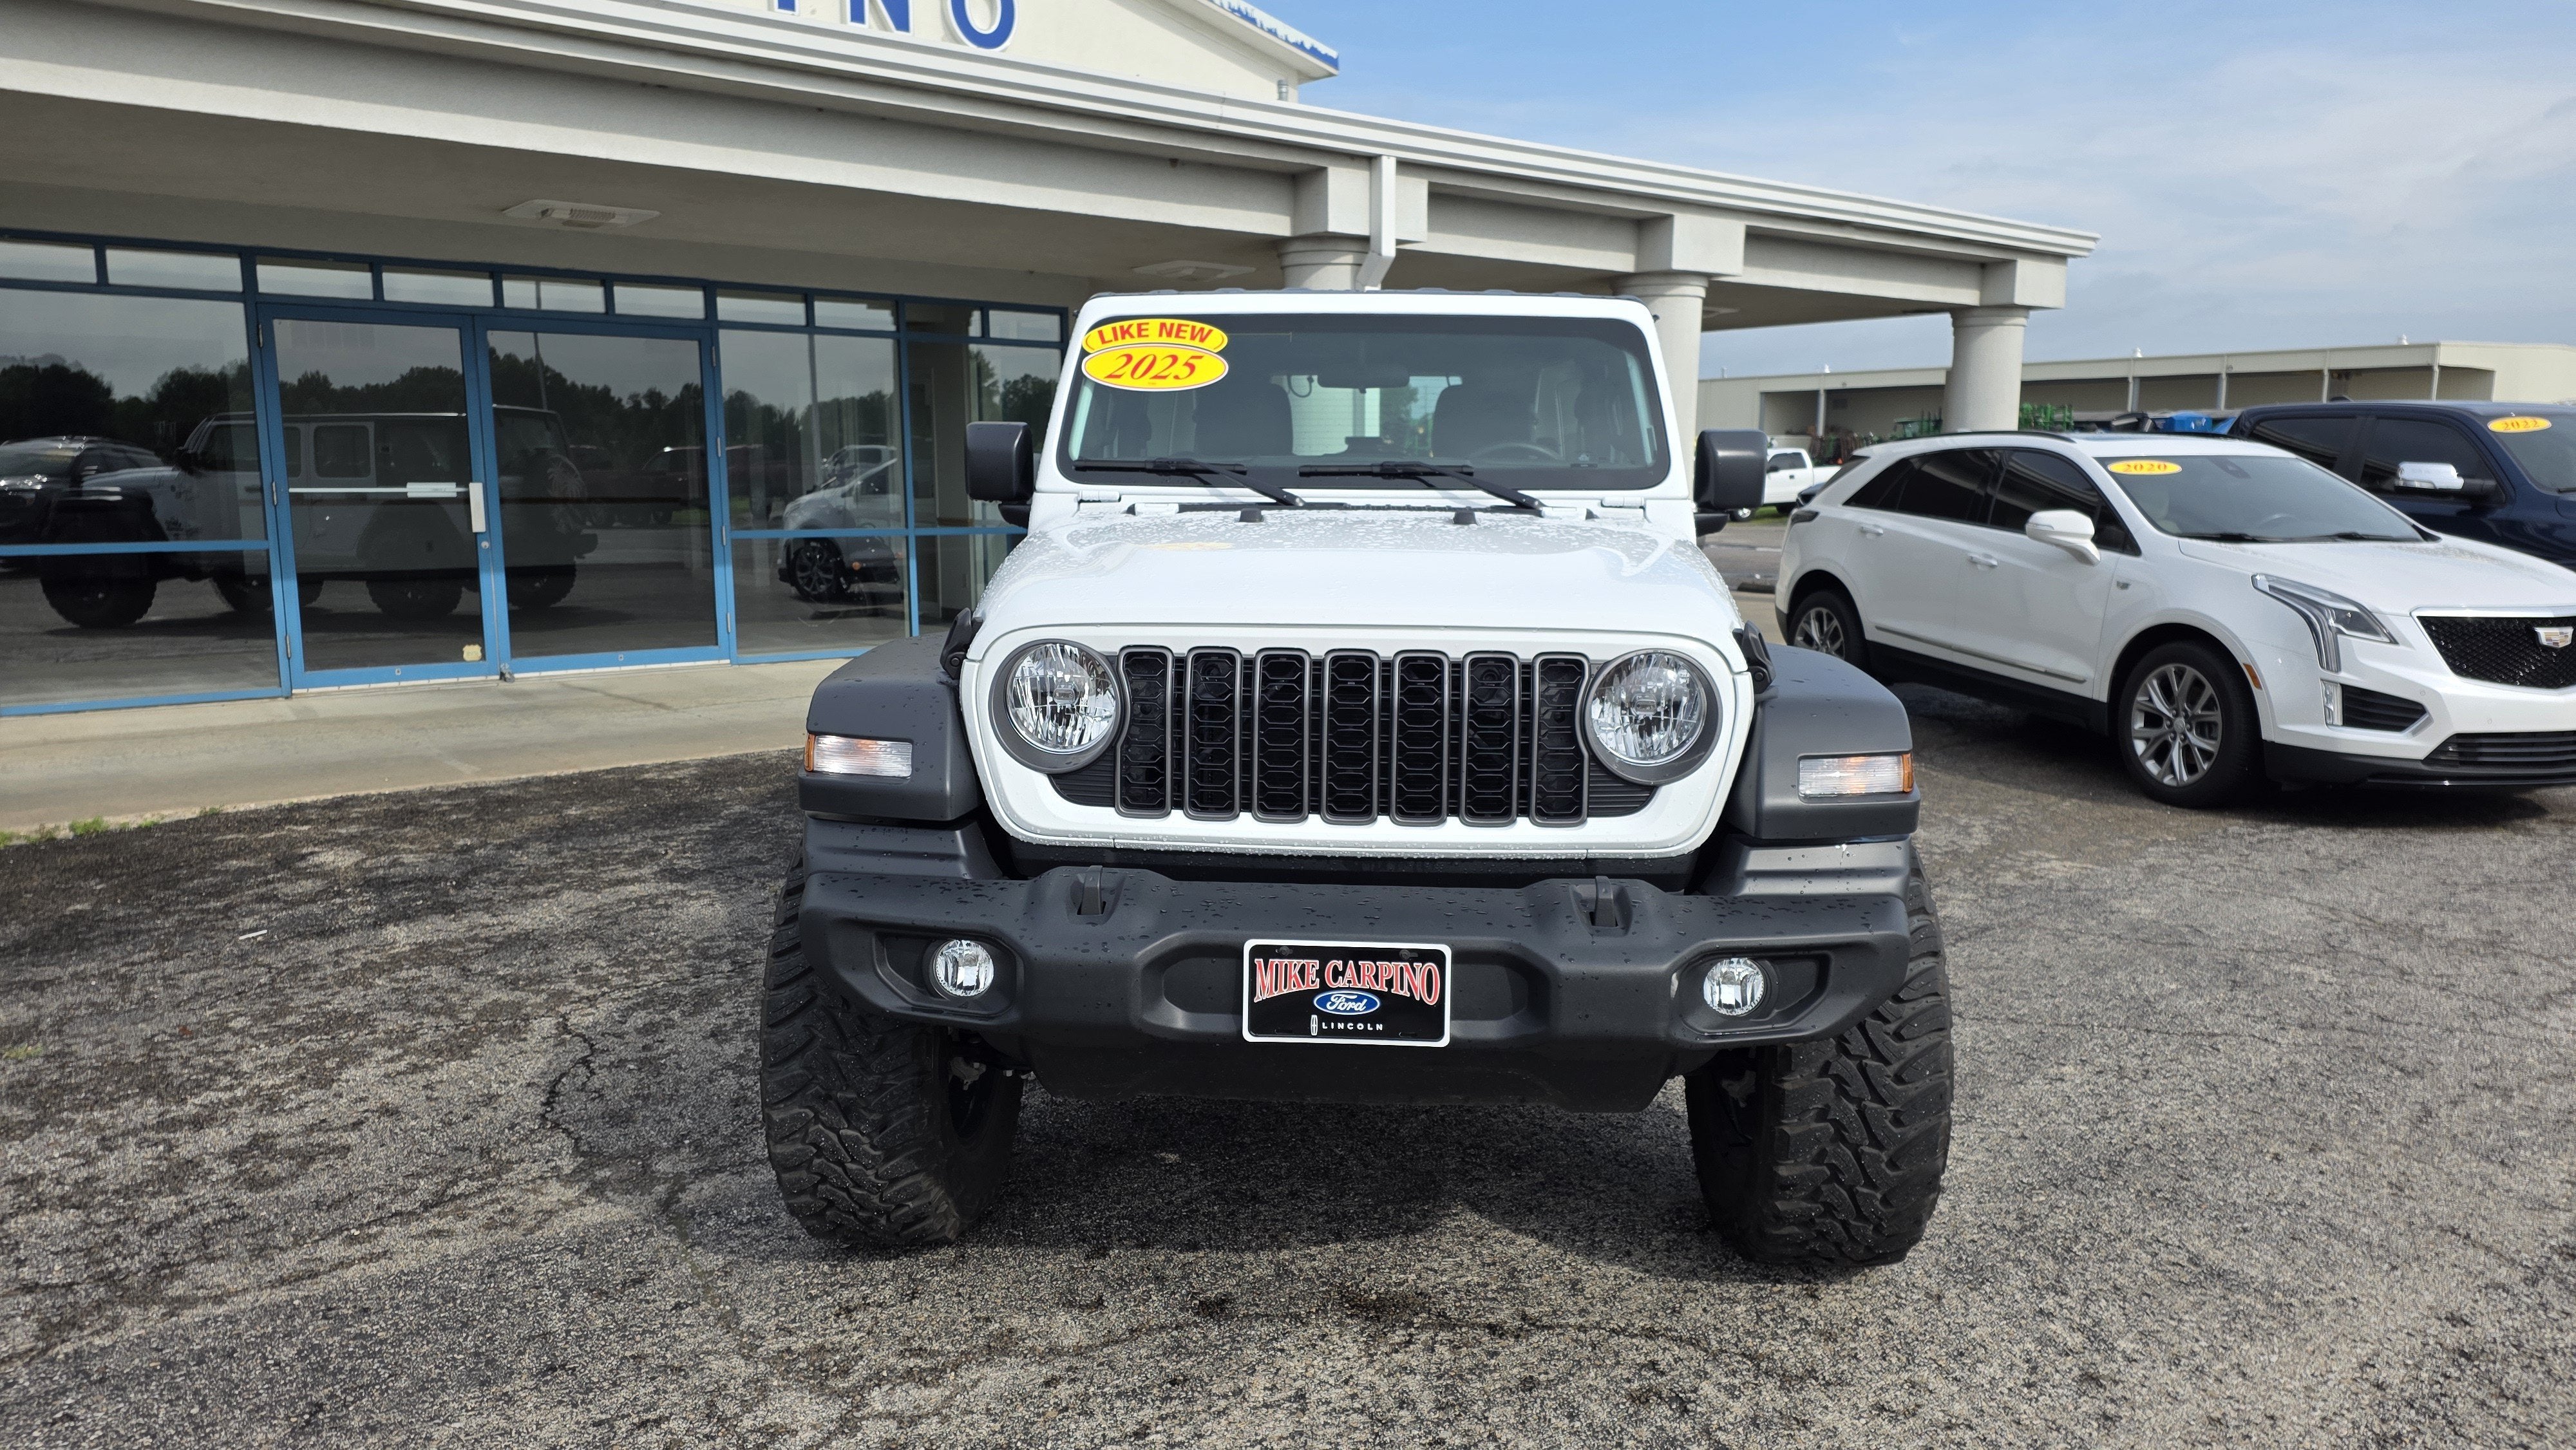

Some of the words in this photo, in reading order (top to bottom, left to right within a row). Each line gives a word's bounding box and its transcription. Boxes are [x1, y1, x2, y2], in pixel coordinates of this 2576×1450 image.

[1097, 323, 1150, 344] LIKE
[1159, 322, 1213, 343] NEW
[1104, 353, 1204, 380] 2025
[2503, 419, 2540, 431] 2022
[2123, 463, 2168, 472] 2020
[1254, 959, 1320, 1003] MIKE
[1324, 960, 1441, 1005] CARPINO
[1326, 994, 1368, 1012] Ford
[1322, 1022, 1383, 1031] LINCOLN
